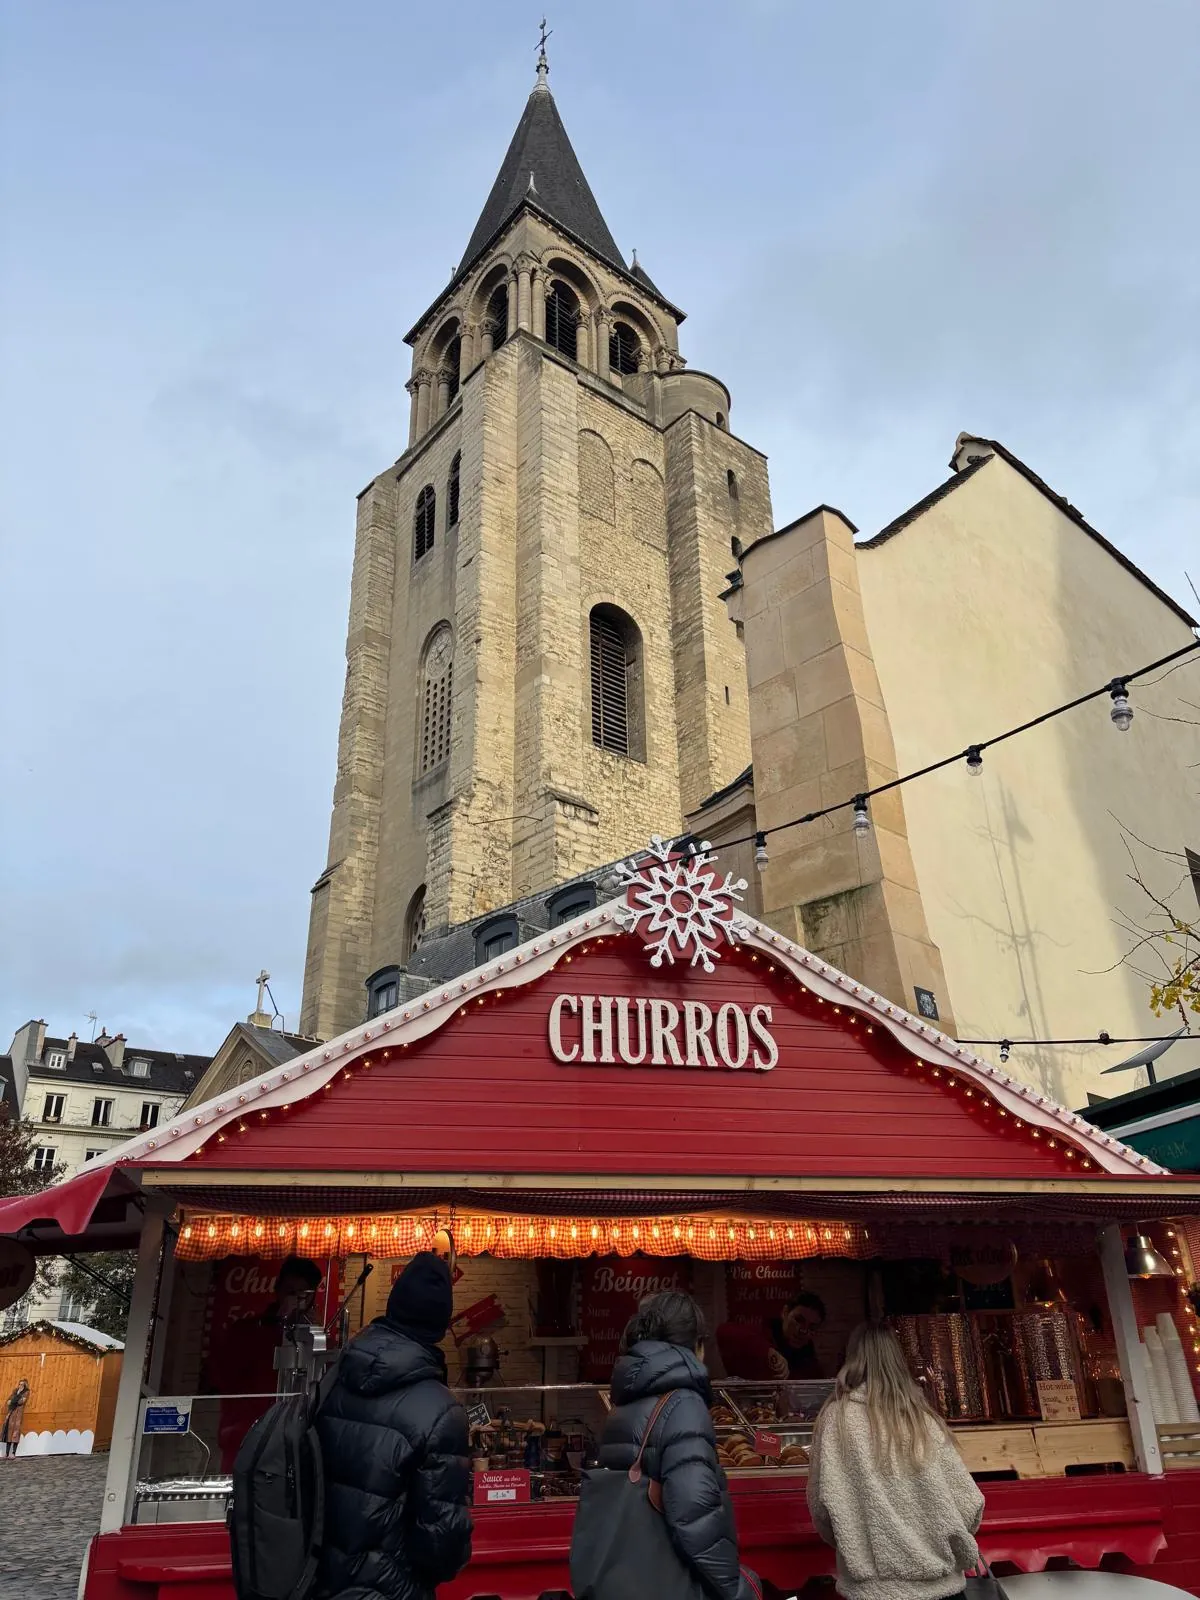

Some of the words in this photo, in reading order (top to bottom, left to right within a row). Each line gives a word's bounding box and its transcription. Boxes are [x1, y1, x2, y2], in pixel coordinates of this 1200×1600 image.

[549, 994, 779, 1070] CHURROS
[592, 1267, 680, 1299] Beignet
[755, 1264, 796, 1279] Chaud
[482, 1472, 503, 1484] Sauce
